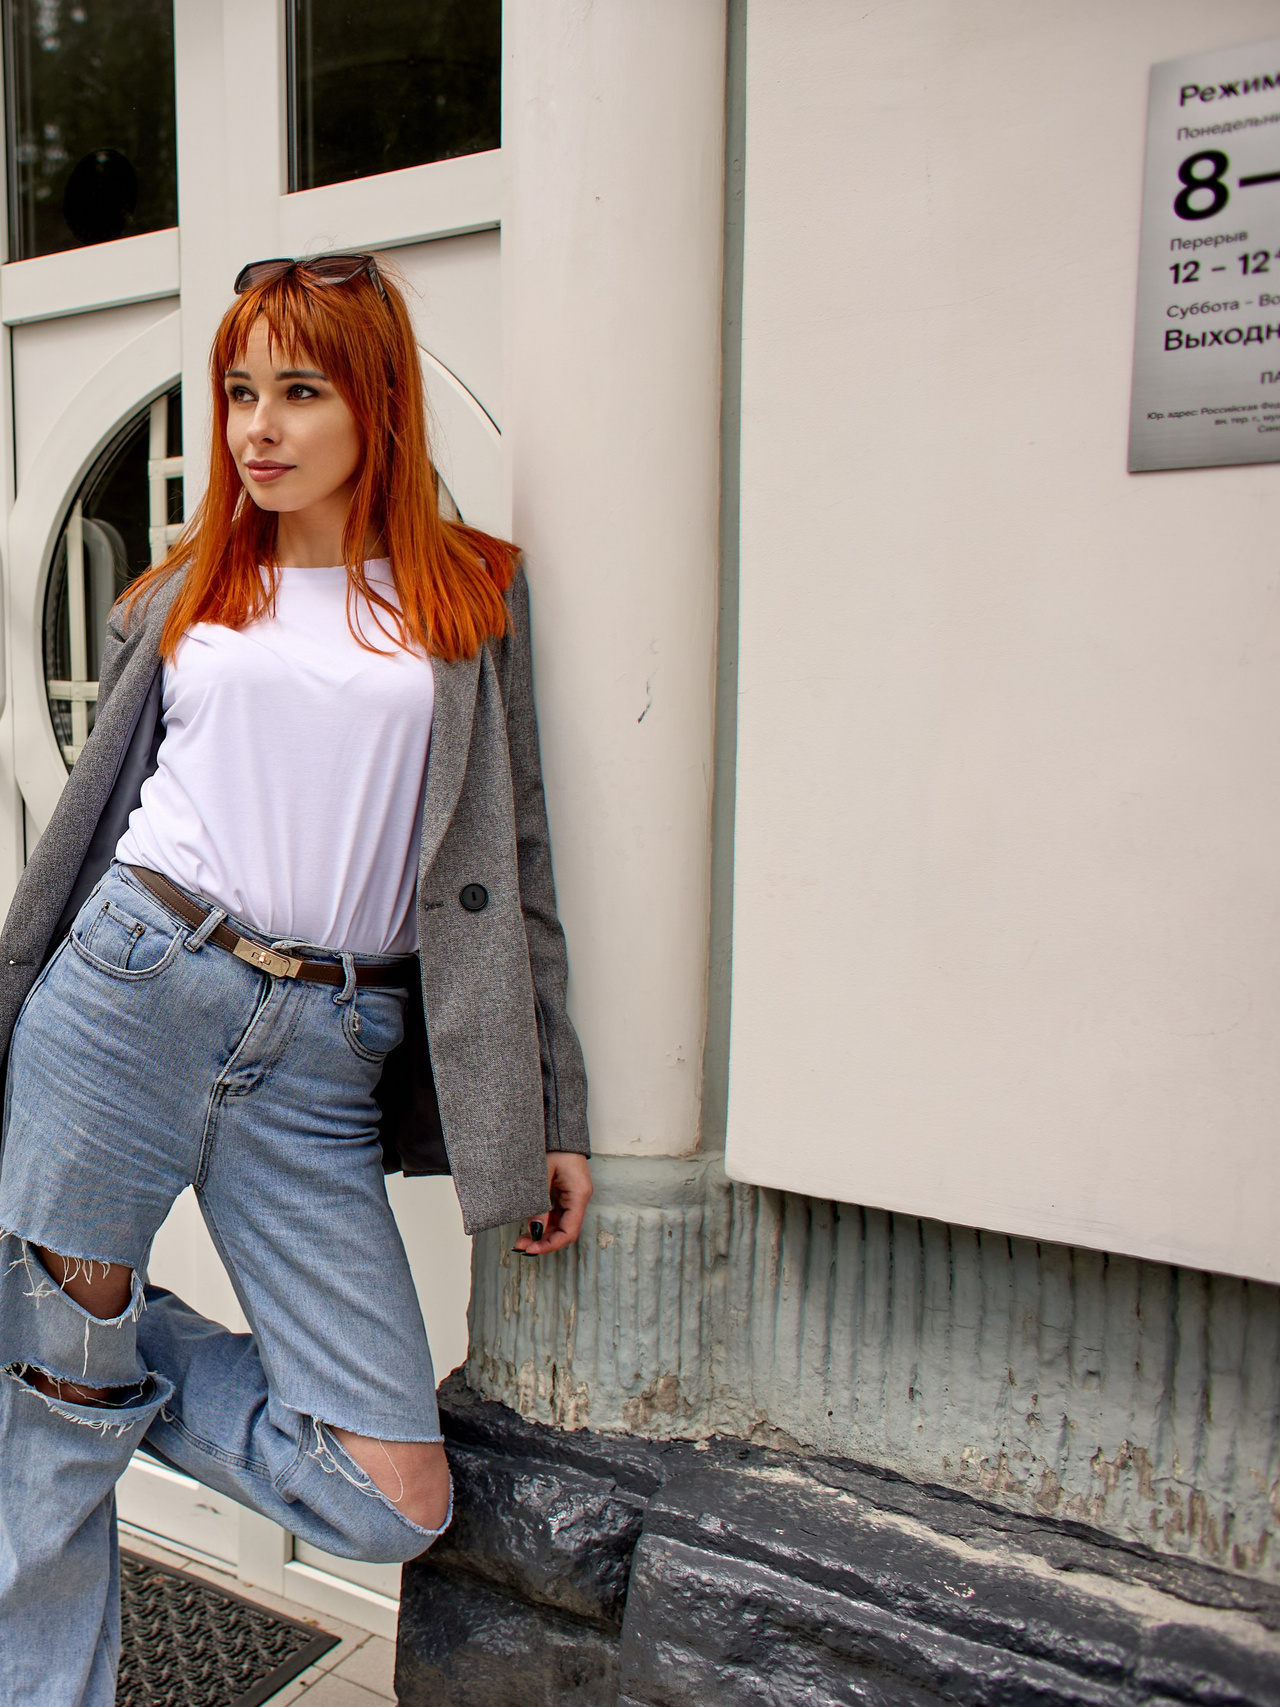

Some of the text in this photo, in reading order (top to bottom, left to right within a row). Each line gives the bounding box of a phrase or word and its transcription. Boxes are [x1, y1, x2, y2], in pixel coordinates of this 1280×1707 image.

[1179, 72, 1280, 107] Режим
[1173, 149, 1230, 222] 8
[1170, 231, 1249, 251] Перерыв
[1169, 260, 1201, 285] 12
[1166, 299, 1240, 320] Суббота
